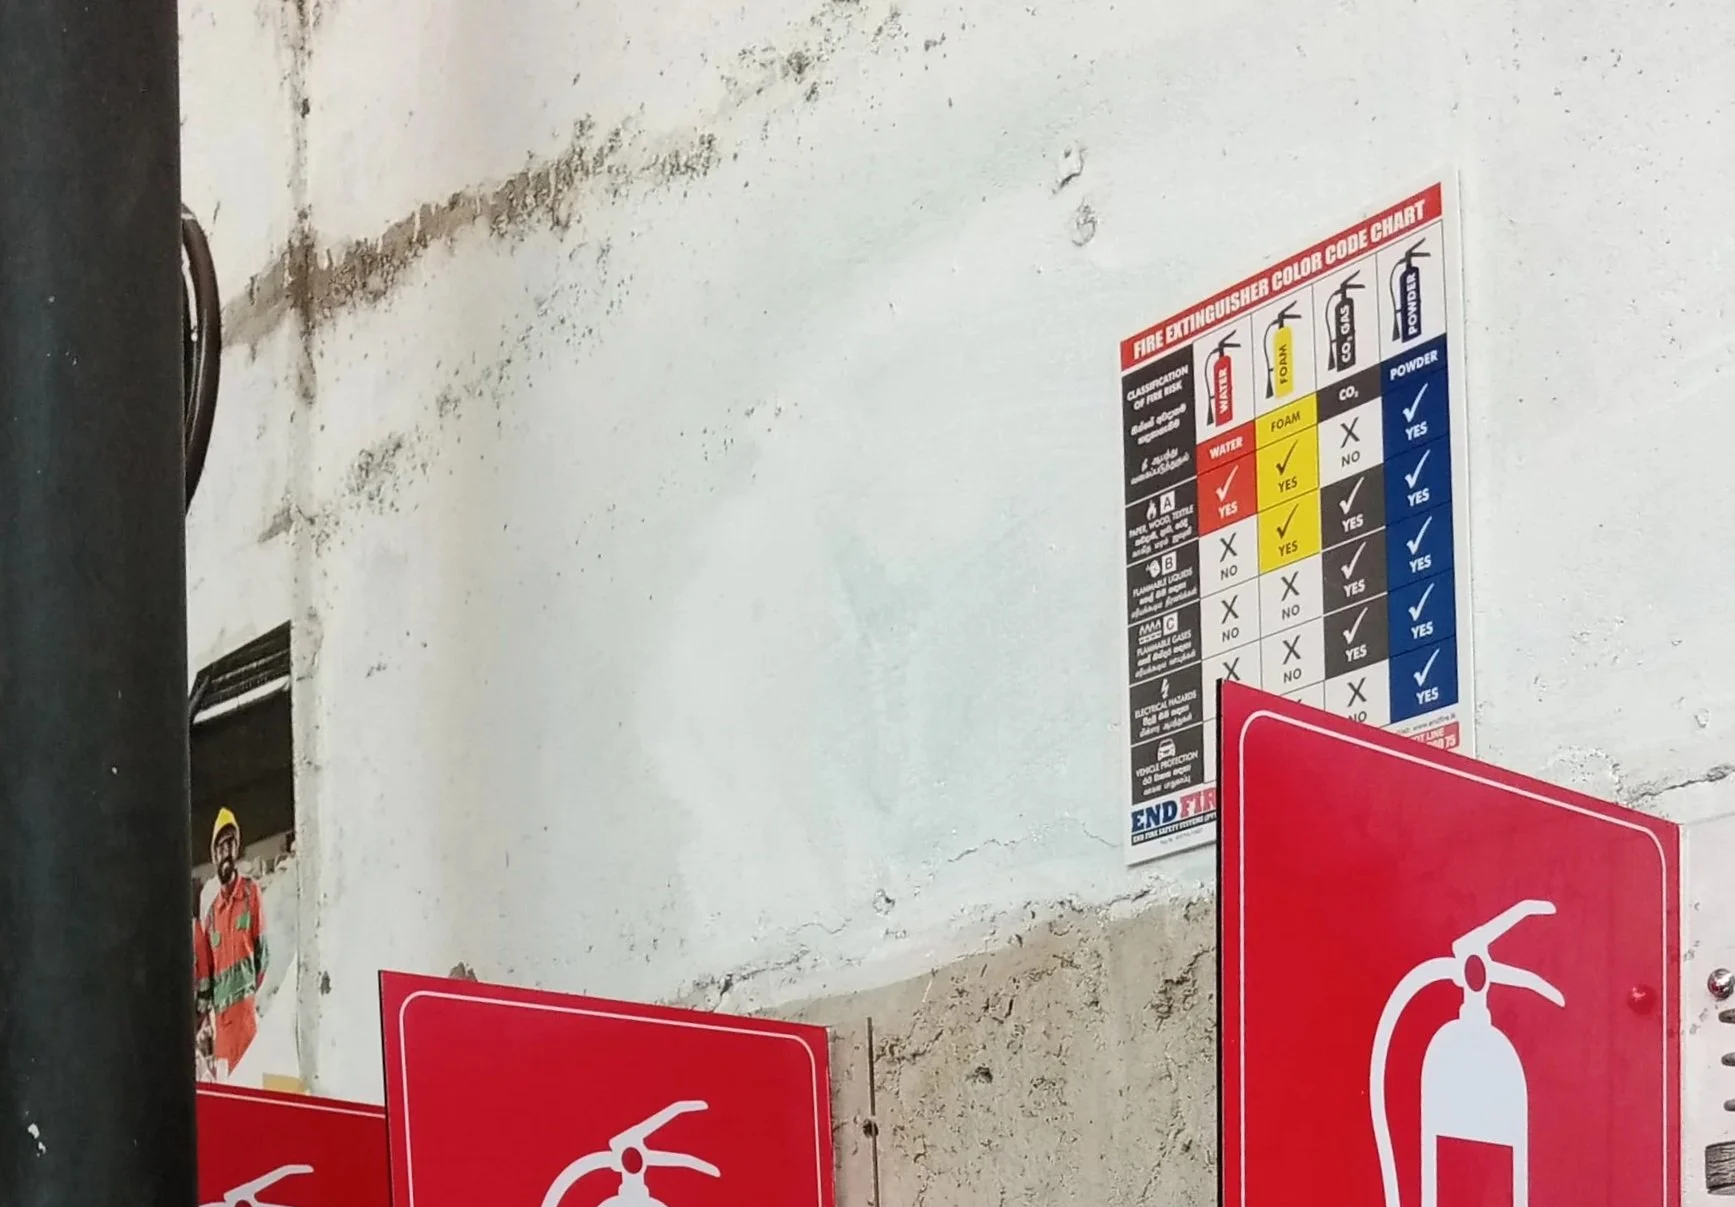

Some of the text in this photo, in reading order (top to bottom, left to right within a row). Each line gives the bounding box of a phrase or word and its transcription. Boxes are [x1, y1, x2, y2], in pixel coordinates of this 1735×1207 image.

[1133, 200, 1426, 360] FIRE EXTINGUISHER COLOR CODE CHART
[1406, 272, 1418, 335] POWDER
[1340, 304, 1350, 335] GAS
[1279, 343, 1288, 385] FOAM
[1390, 350, 1438, 380] POWDER
[1126, 365, 1189, 402] CLASSIFICATION
[1219, 367, 1228, 414] WATER
[1133, 380, 1183, 411] OF FIRE RISK
[1271, 411, 1301, 432] FOAM
[1405, 421, 1428, 441] YES
[1209, 436, 1243, 460] WATER
[1341, 450, 1361, 467] NO
[1278, 476, 1298, 493] YES
[1163, 496, 1172, 511] A
[1407, 488, 1430, 507] YES
[1218, 501, 1238, 519] YES
[1341, 513, 1364, 533] YES
[1278, 540, 1298, 557] YES
[1165, 556, 1173, 570] B
[1220, 564, 1238, 581] NO
[1409, 554, 1432, 573] YES
[1343, 578, 1366, 598] YES
[1281, 604, 1300, 620] NO
[1166, 617, 1175, 630] C
[1411, 621, 1434, 640] YES
[1221, 626, 1240, 643] NO
[1345, 644, 1367, 662] YES
[1283, 667, 1302, 683] NO
[1134, 701, 1168, 719] ELECTRICAL
[1168, 689, 1197, 707] HAZARDS
[1416, 686, 1439, 705] YES
[1348, 711, 1367, 723] NO
[1160, 750, 1199, 770] PROTECTION
[1131, 800, 1178, 833] END
